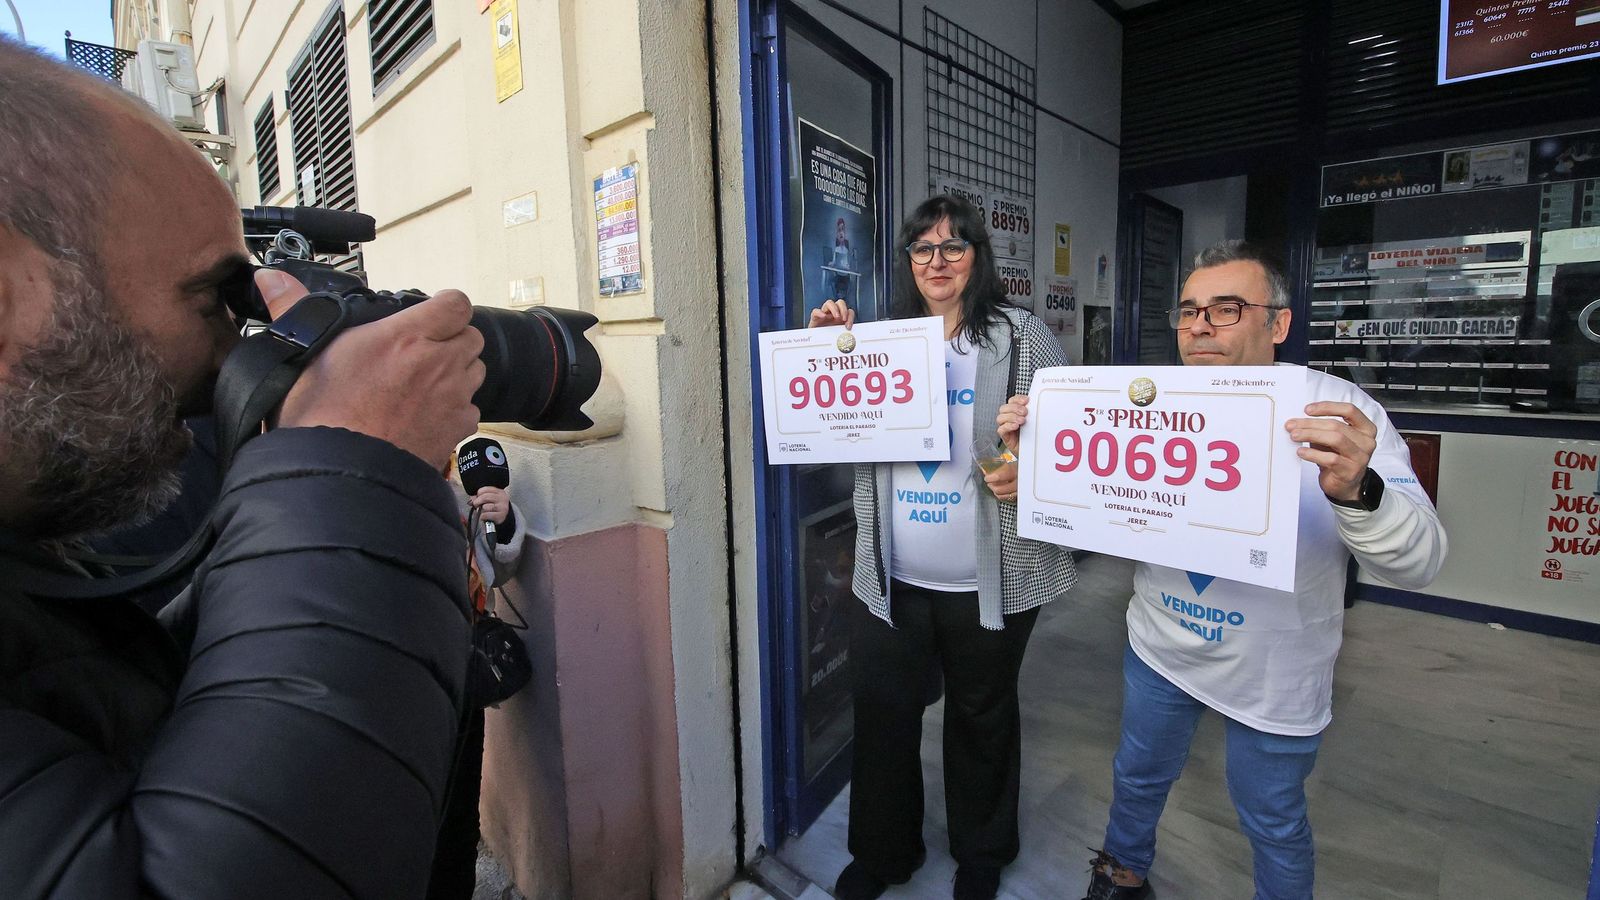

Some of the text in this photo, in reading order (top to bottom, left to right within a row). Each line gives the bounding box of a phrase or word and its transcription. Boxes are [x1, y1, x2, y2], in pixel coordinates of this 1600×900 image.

[1475, 3, 1510, 16] Quintos
[1490, 29, 1529, 44] 60.000€
[1530, 49, 1557, 59] Quinto
[1558, 44, 1587, 55] premio
[811, 159, 819, 176] ES
[832, 168, 847, 185] COSA
[1346, 190, 1376, 203] llegó
[1381, 188, 1393, 199] el
[1396, 183, 1436, 197] NIÑO!
[1001, 201, 1028, 217] PREMIO
[991, 210, 1030, 235] 88979
[1426, 246, 1484, 257] VIAJERA
[1397, 259, 1419, 267] DEL
[1002, 266, 1028, 279] PREMIO
[1053, 284, 1074, 296] PREMIO
[1046, 294, 1076, 311] 05490
[1357, 318, 1515, 337] ¿EN QUÉ CIUDAD CAERÁ?
[824, 353, 889, 371] PREMIO
[788, 369, 914, 410] 90693
[1231, 378, 1277, 387] Diciembre
[818, 409, 884, 422] VENDIDO AQUÍ
[1107, 407, 1205, 433] PREMIO
[458, 450, 478, 465] Onda
[1053, 428, 1242, 493] 90693
[1553, 450, 1597, 472] CON
[460, 458, 480, 474] Jerez
[1551, 471, 1575, 491] EL
[897, 489, 962, 505] VENDIDO
[1089, 483, 1186, 507] VENDIDO AQUÍ
[1104, 502, 1173, 518] LOTERIA EL PARAISO
[1549, 493, 1600, 515] JUEG
[908, 506, 948, 524] AQUÍ
[1127, 517, 1148, 526] JEREZ
[1044, 520, 1074, 531] NACIONAL
[1547, 515, 1579, 534] NO
[1161, 591, 1245, 626] VENDIDO
